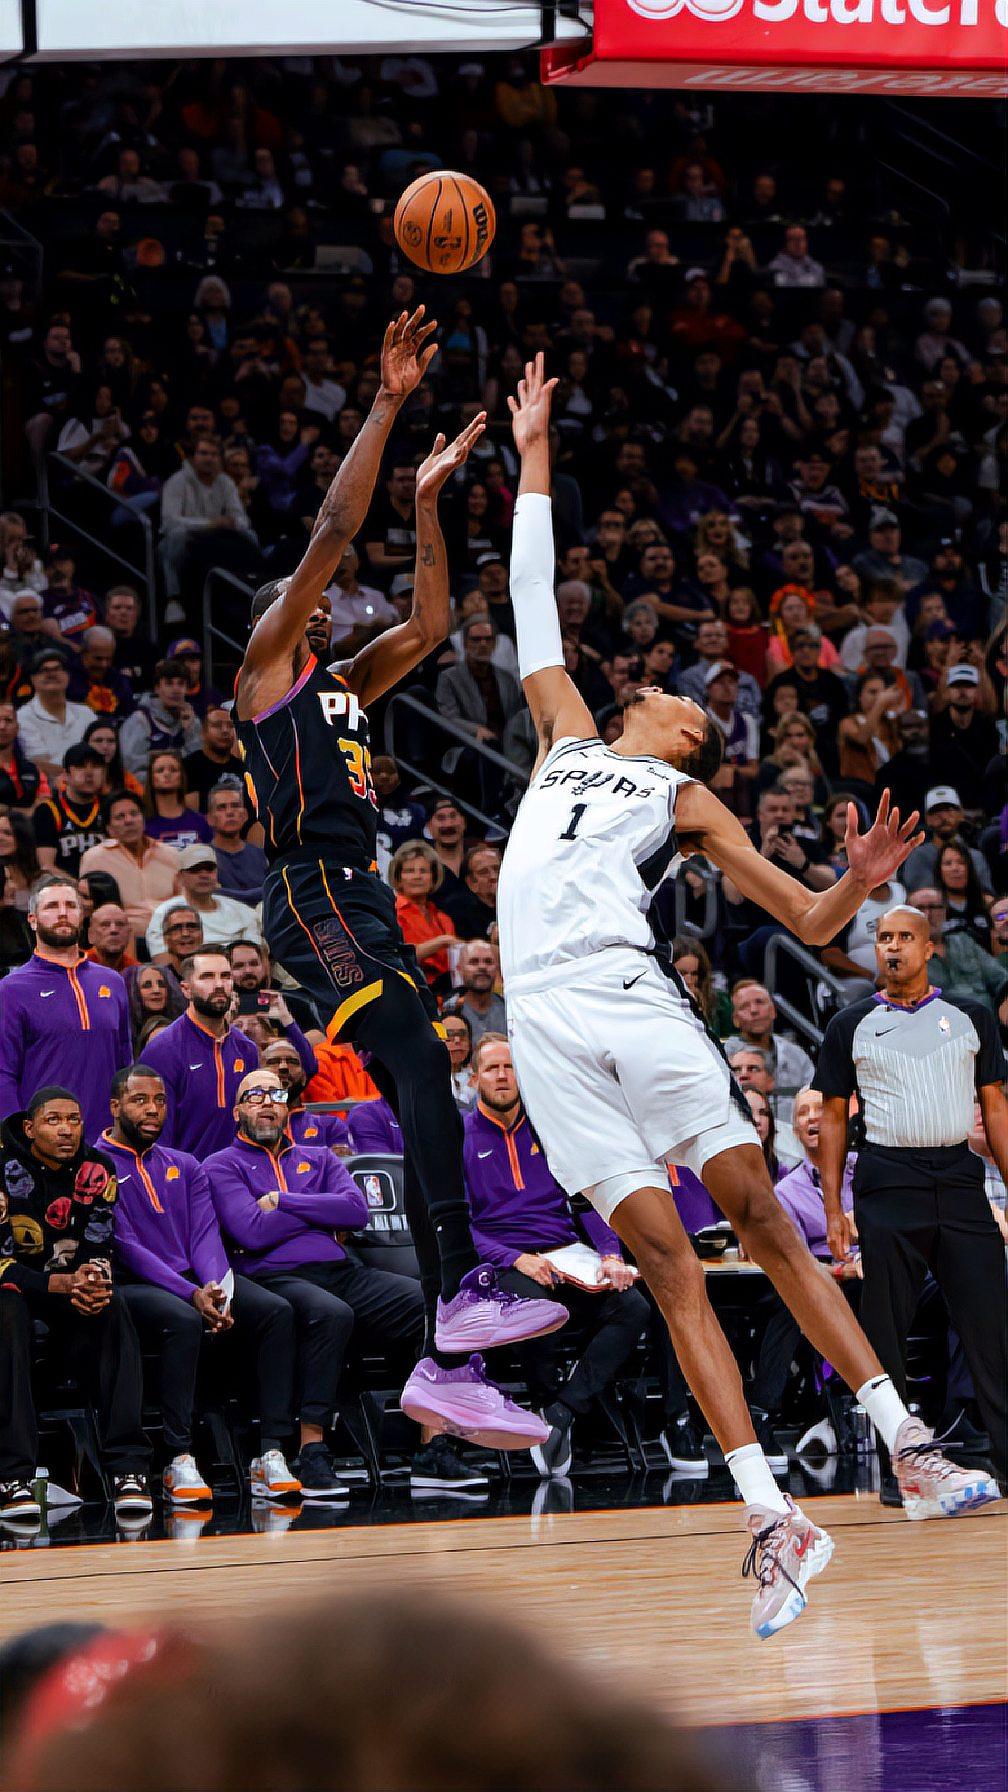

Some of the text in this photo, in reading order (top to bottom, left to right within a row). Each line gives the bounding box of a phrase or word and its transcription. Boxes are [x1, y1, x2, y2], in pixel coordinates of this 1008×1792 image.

[684, 69, 1008, 94] ateFarm
[539, 770, 656, 799] SPURS
[558, 803, 589, 840] 1
[59, 832, 106, 857] PH
